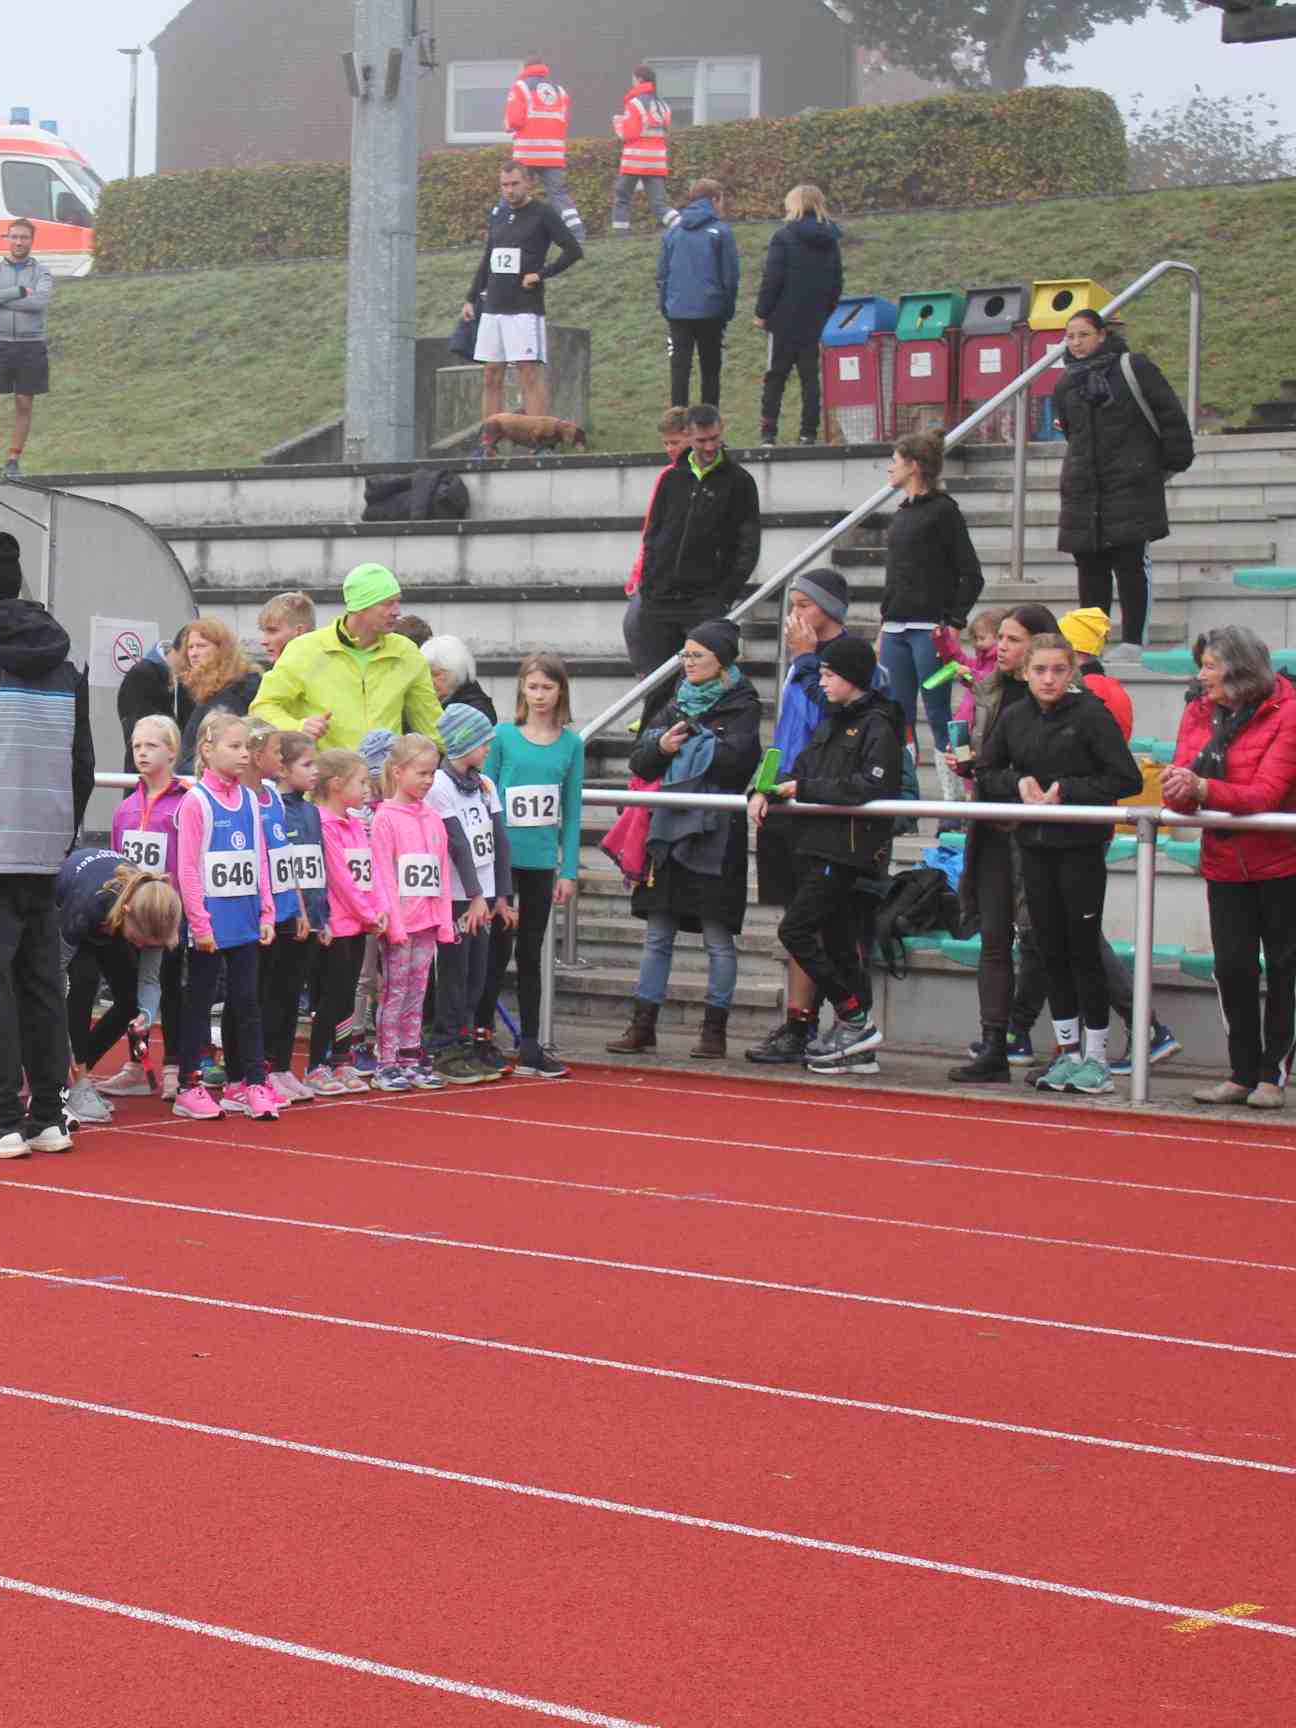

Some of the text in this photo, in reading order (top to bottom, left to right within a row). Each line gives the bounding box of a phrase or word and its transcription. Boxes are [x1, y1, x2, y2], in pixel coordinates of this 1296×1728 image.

[497, 254, 512, 268] 12
[511, 795, 555, 818] 612
[211, 861, 254, 888] 646
